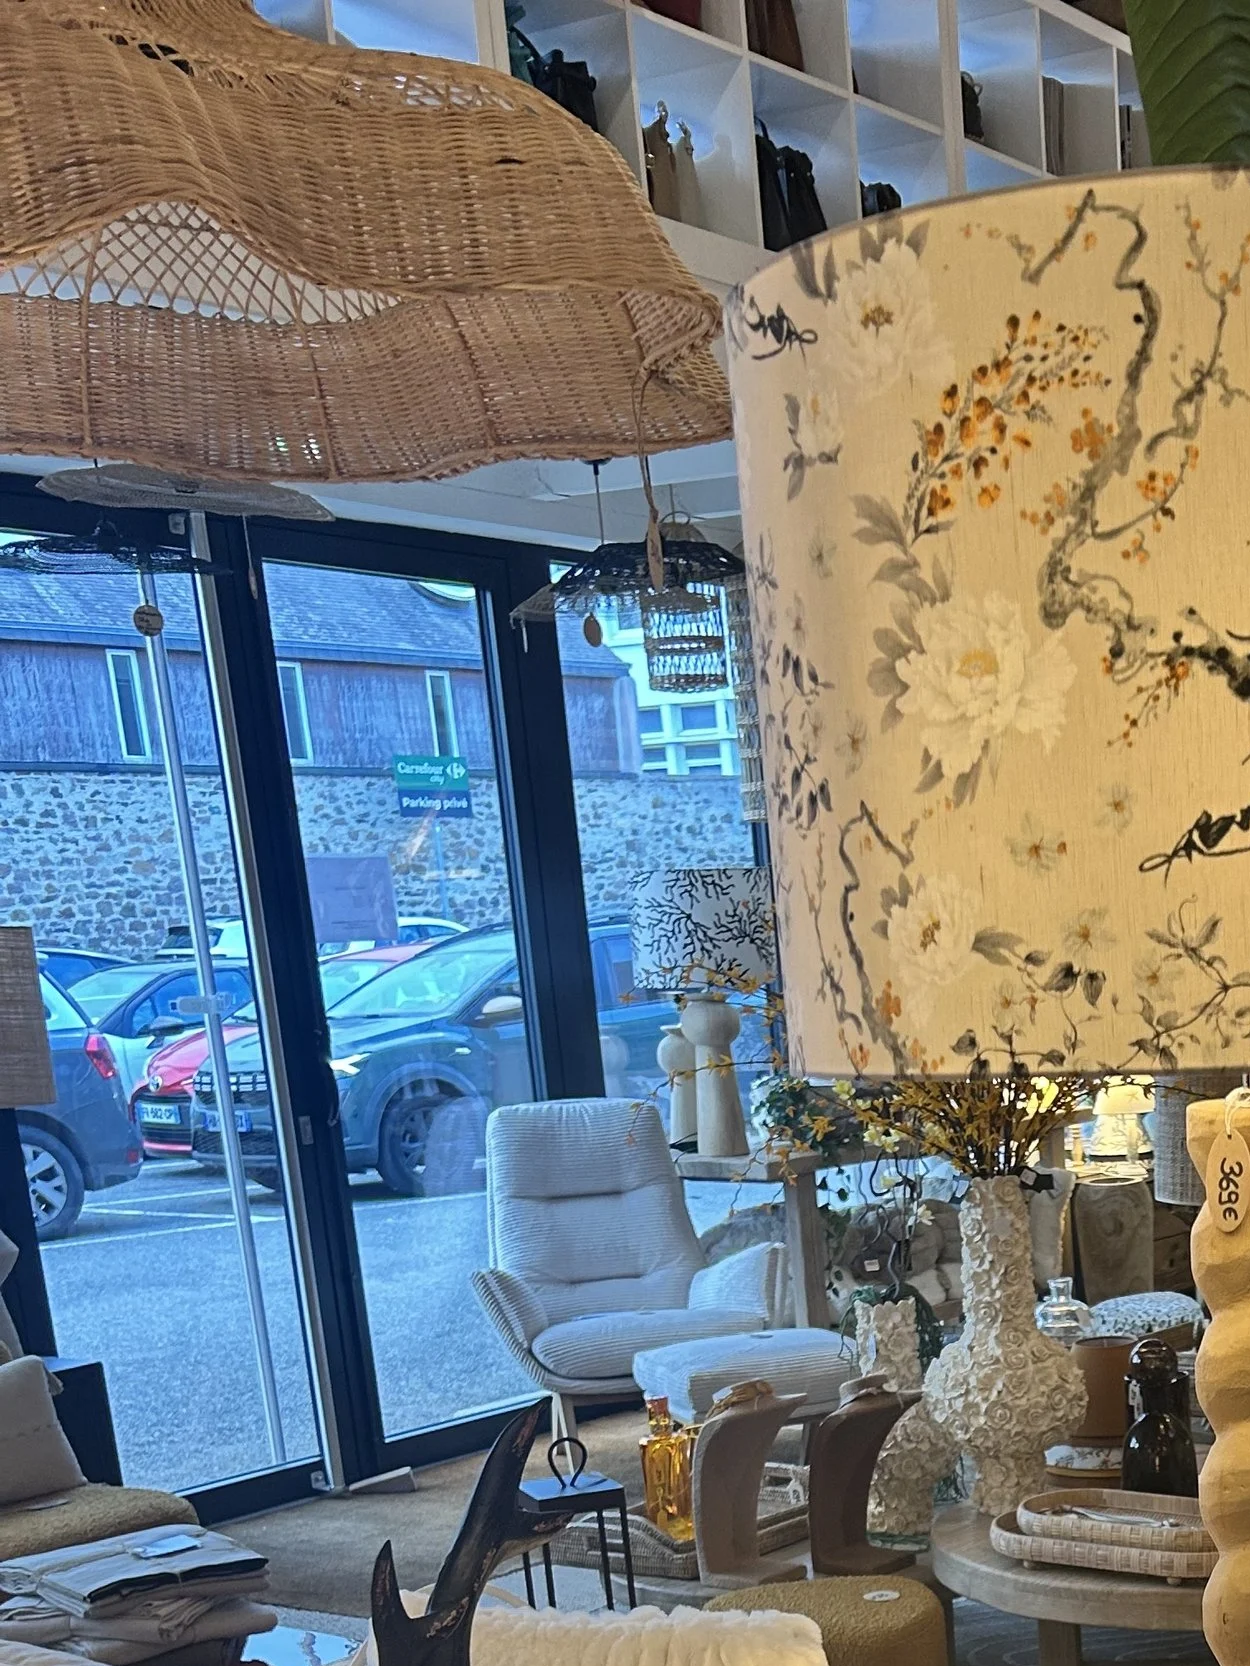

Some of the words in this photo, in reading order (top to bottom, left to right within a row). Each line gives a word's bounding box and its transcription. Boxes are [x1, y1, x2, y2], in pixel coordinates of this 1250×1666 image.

[397, 762, 444, 774] Carrefour
[402, 796, 442, 811] Parking
[443, 796, 468, 811] privé
[1218, 1157, 1244, 1221] 369€
